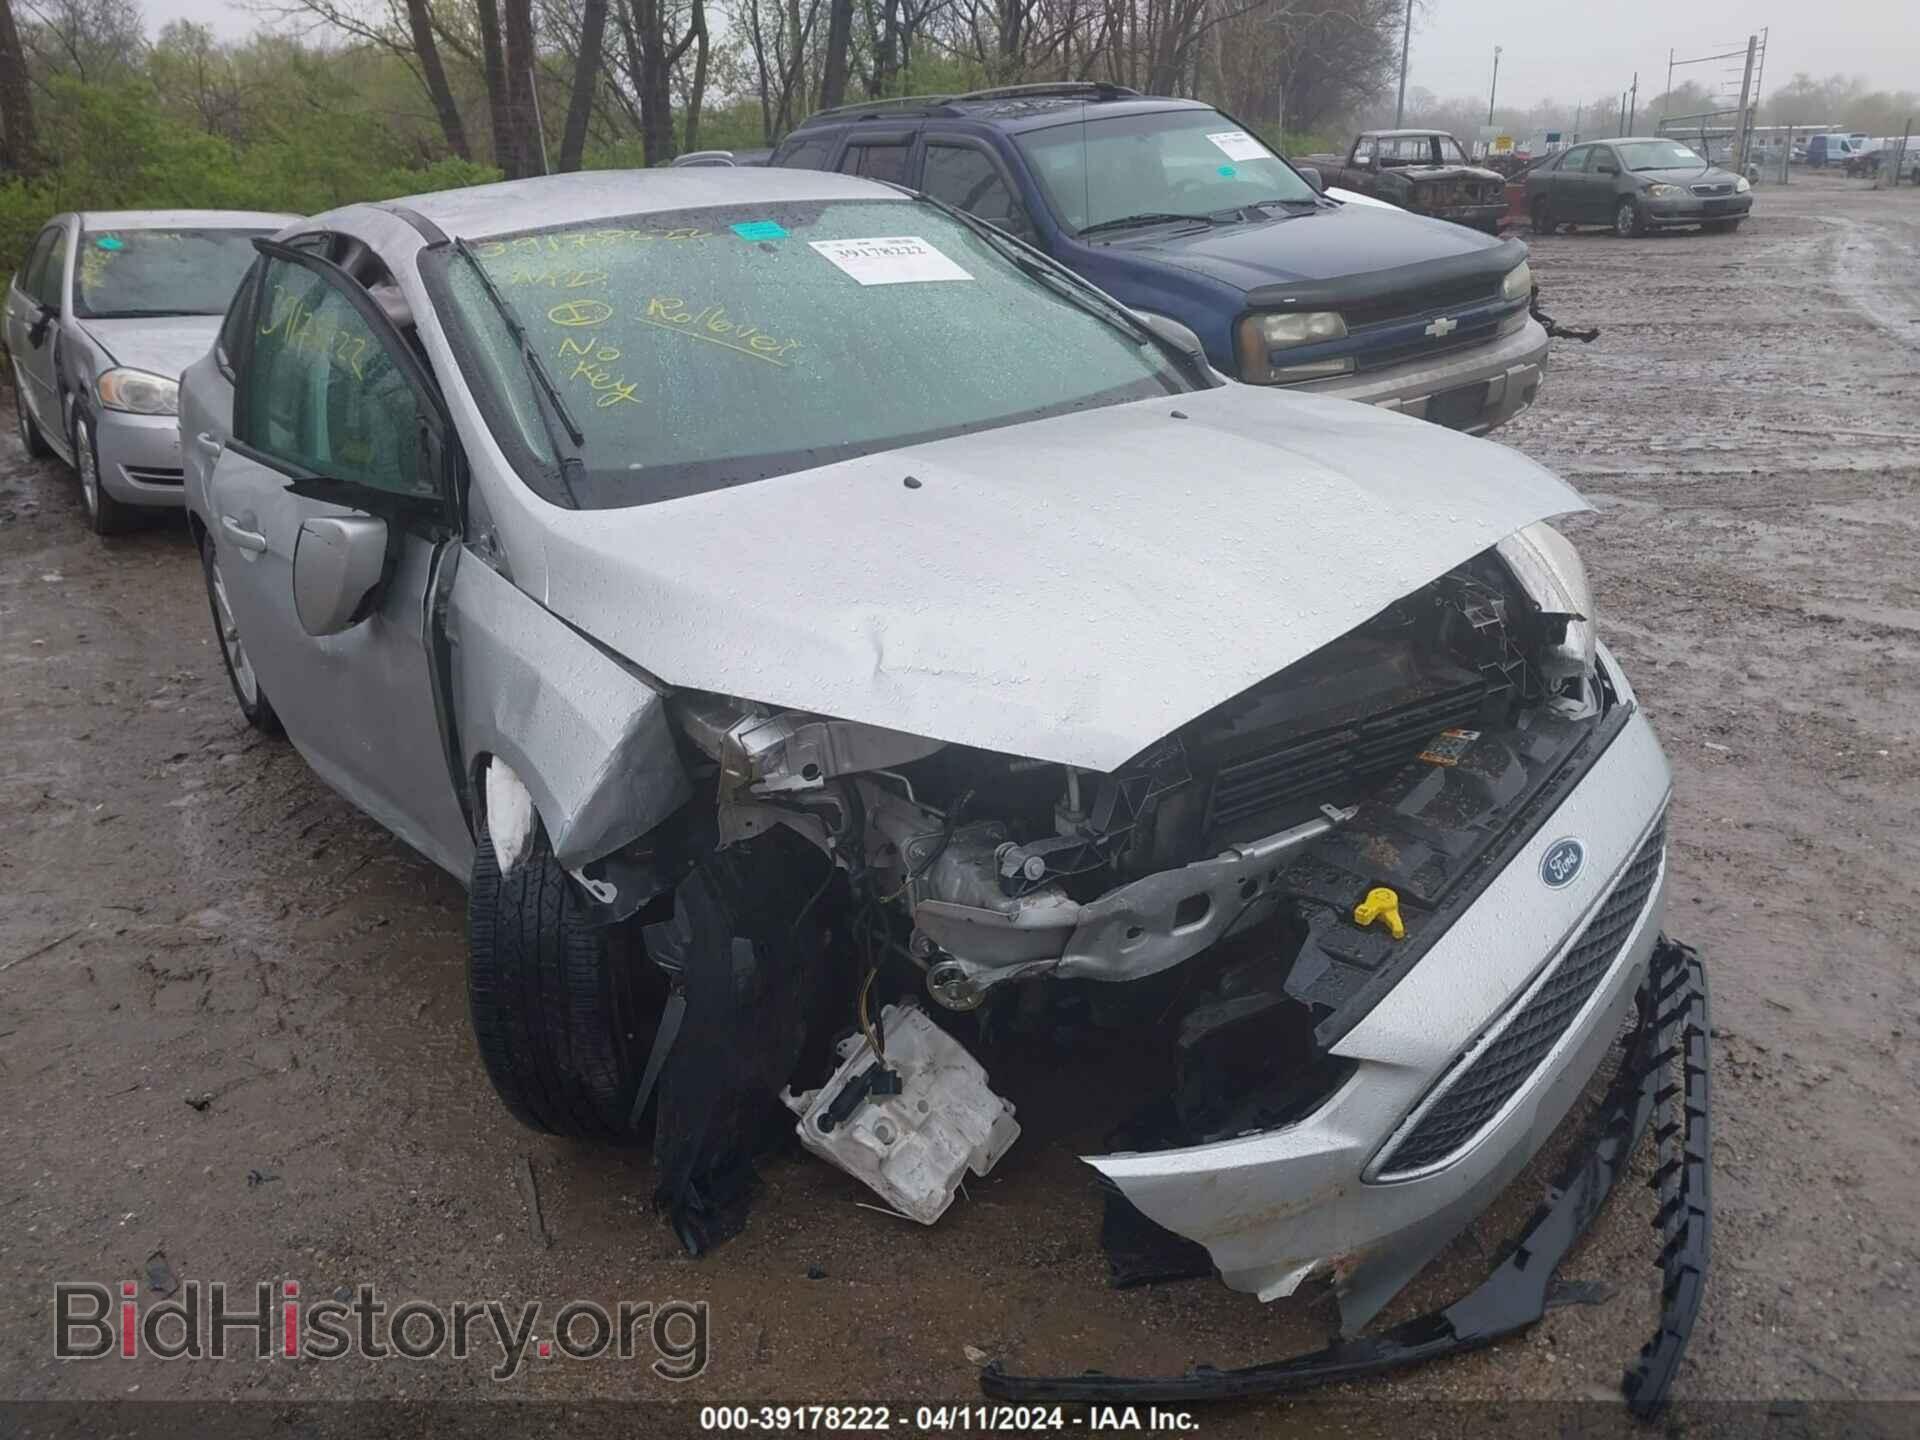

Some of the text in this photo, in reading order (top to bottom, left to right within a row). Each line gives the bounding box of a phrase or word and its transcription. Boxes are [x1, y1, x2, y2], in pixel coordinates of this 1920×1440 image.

[648, 297, 802, 357] Rollover
[557, 337, 621, 362] No
[569, 360, 642, 408] Key
[1549, 847, 1578, 880] Ford
